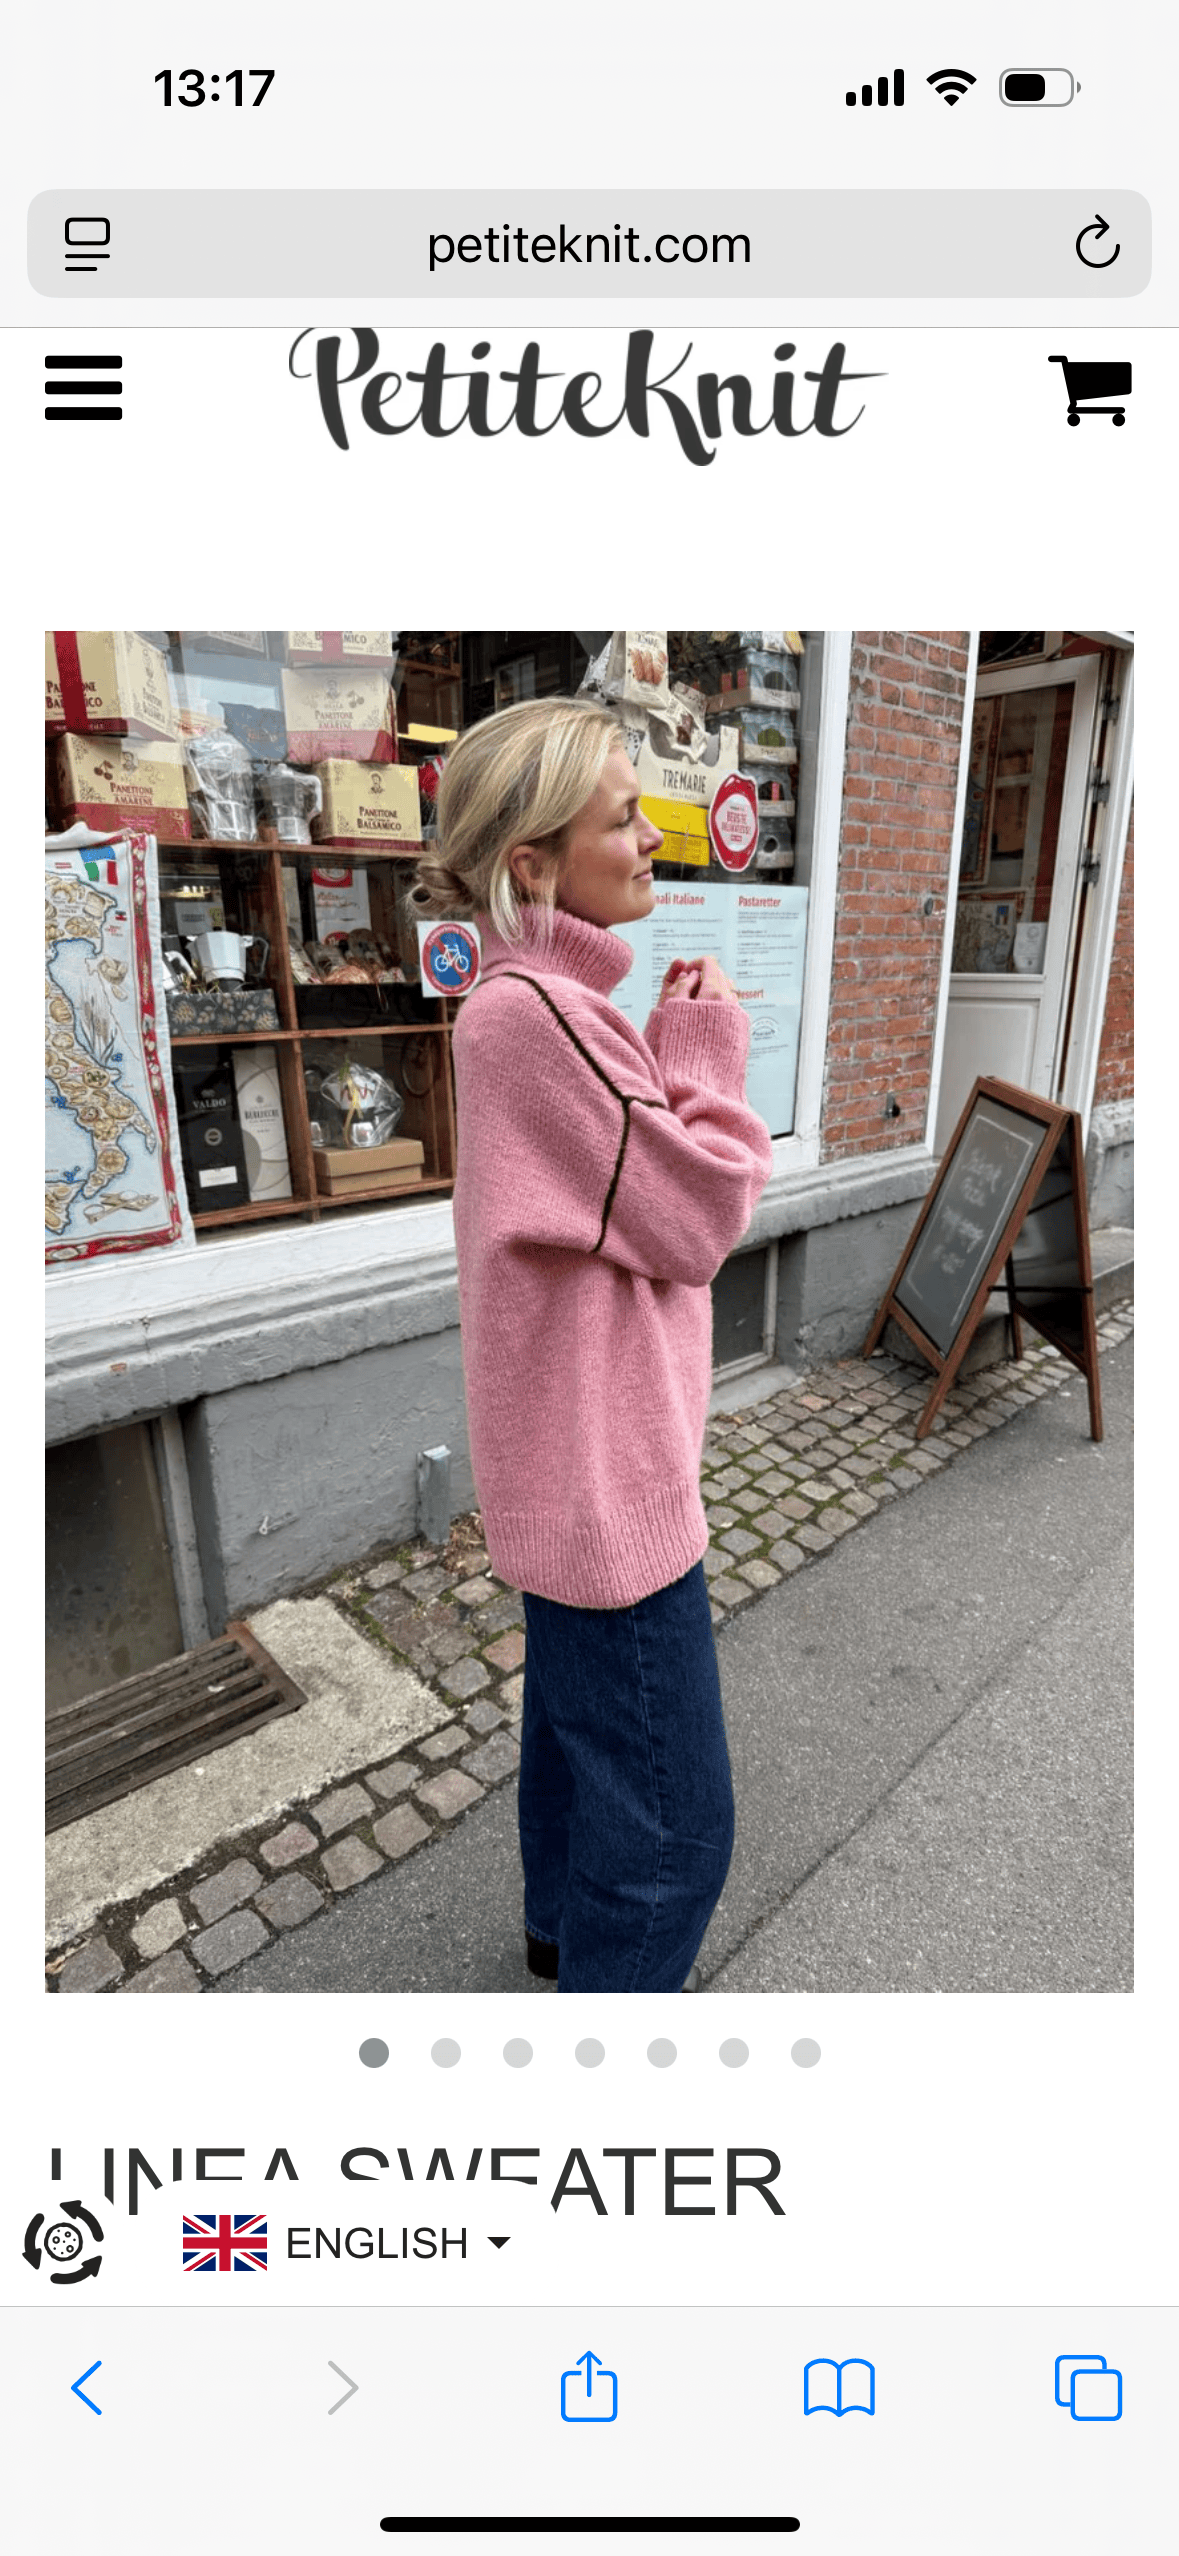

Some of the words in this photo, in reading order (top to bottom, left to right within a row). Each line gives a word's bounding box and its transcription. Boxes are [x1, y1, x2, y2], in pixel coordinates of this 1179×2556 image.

[155, 69, 274, 107] 13:17
[430, 224, 750, 271] petiteknit.com
[110, 782, 153, 794] PANETTONE
[359, 806, 397, 818] PANETTONE
[356, 818, 402, 831] BALSAMICO
[738, 896, 781, 907] Pastaretter
[193, 1098, 227, 1108] VALDO
[288, 2227, 466, 2259] ENGLISH
